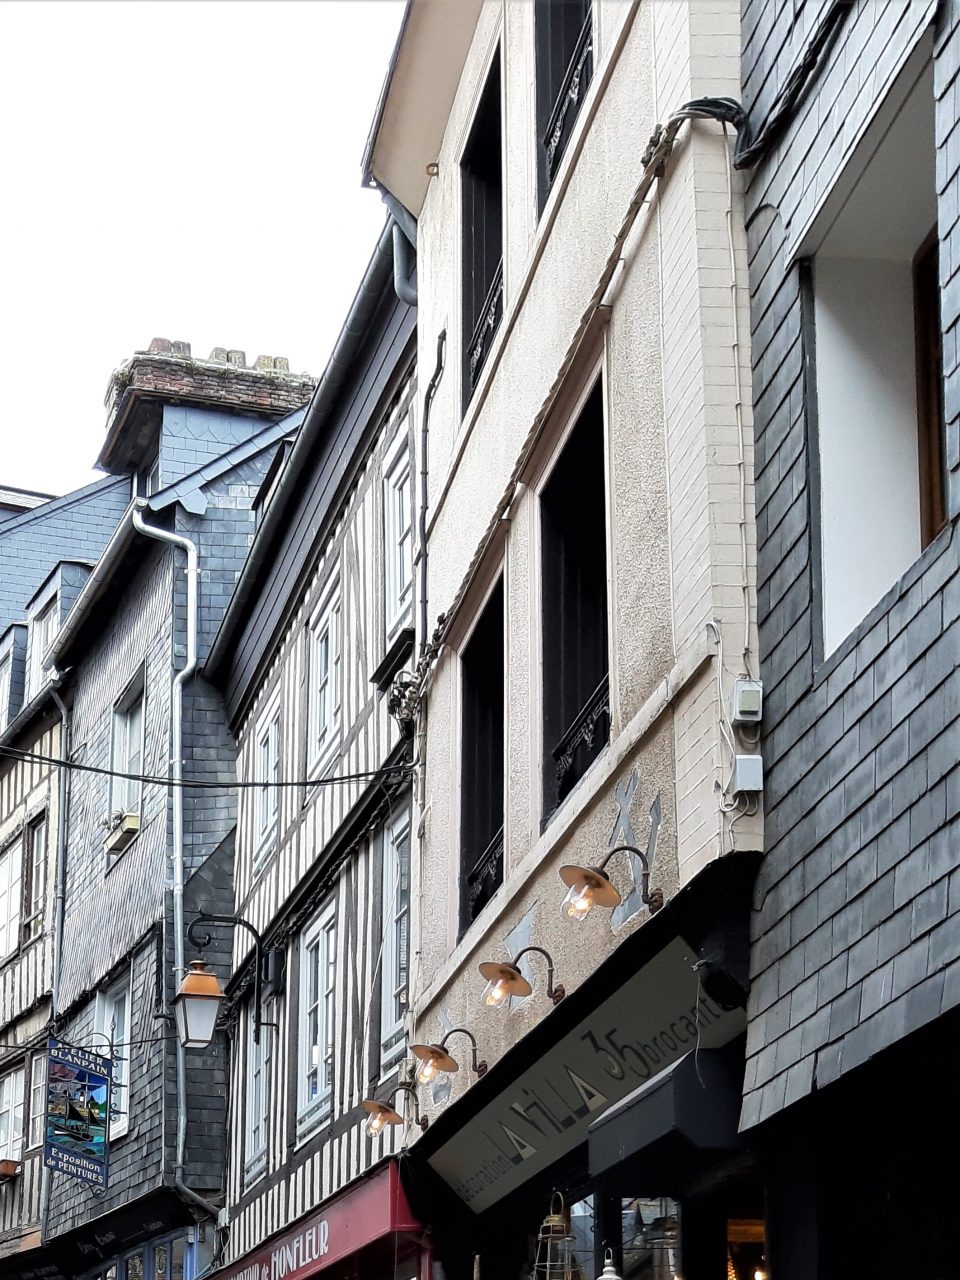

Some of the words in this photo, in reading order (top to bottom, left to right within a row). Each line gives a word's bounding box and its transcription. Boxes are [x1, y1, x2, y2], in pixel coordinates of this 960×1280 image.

[51, 1049, 108, 1076] BLANPAIN
[483, 1120, 537, 1166] LA
[580, 1027, 651, 1081] 35
[635, 996, 726, 1065] brocant
[46, 1157, 56, 1167] de
[58, 1160, 104, 1184] PEINTURES
[51, 1147, 100, 1173] Exposition
